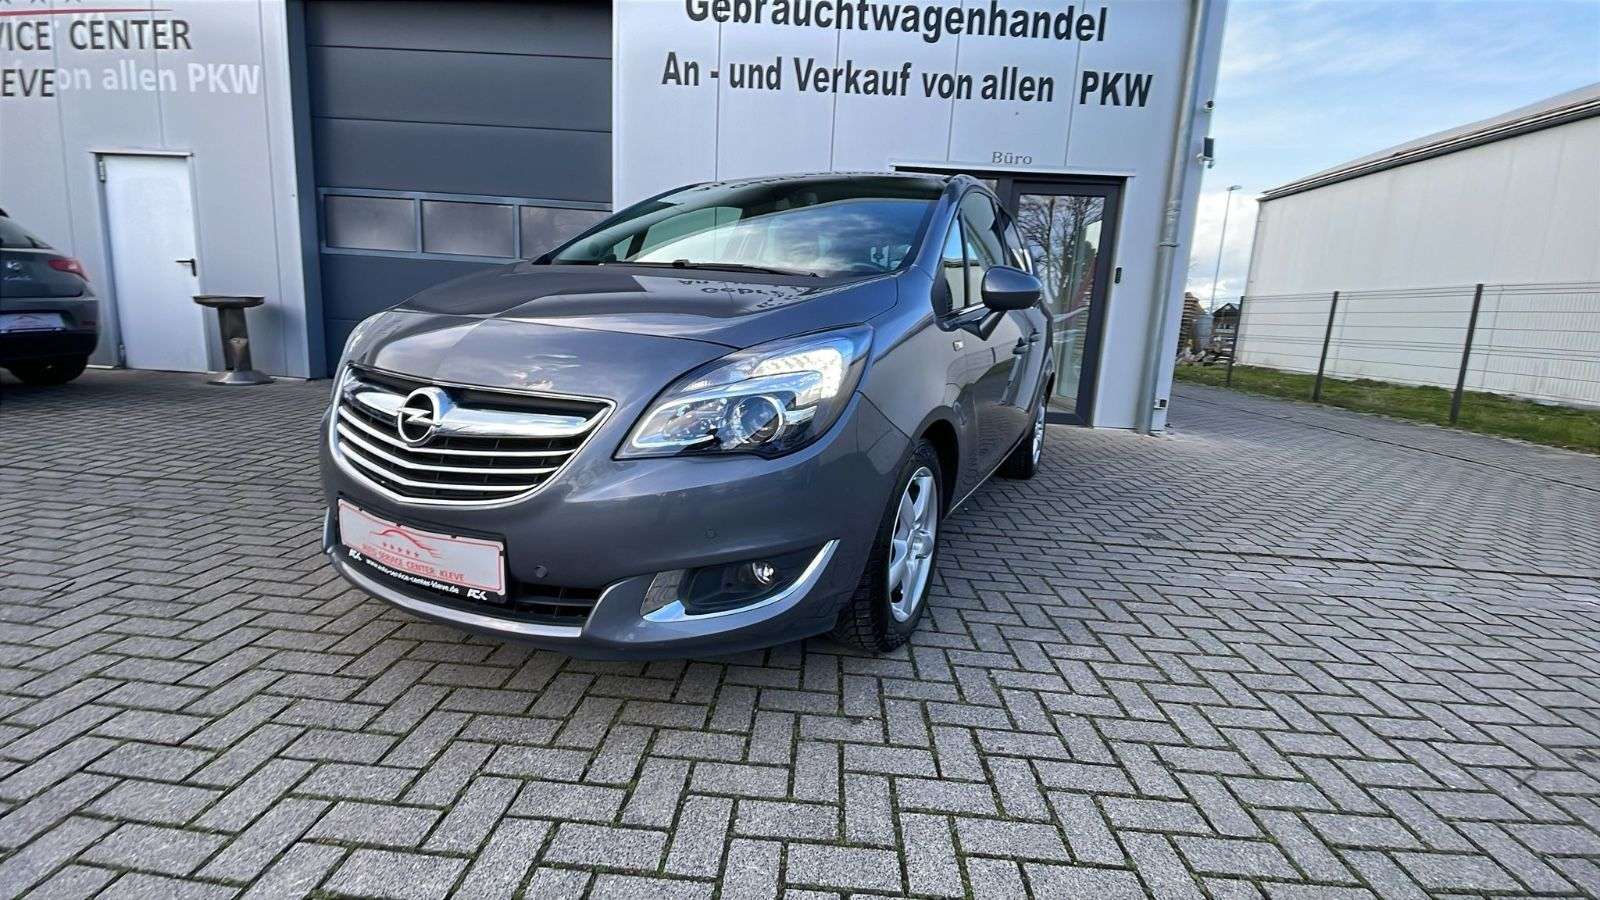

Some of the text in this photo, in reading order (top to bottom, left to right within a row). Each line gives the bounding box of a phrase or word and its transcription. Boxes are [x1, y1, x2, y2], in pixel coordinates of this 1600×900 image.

[69, 19, 193, 50] CENTER
[686, 0, 1107, 43] Gebrauchtwagenhandel
[1, 68, 56, 97] EVE
[56, 60, 261, 95] on allen PKW
[661, 50, 700, 87] An
[729, 56, 782, 90] und
[793, 57, 913, 97] Verkauf
[922, 71, 973, 100] von
[981, 66, 1054, 102] allen
[1079, 70, 1153, 108] PKW
[991, 151, 1033, 165] Büro
[406, 561, 434, 575] CENTER
[439, 570, 464, 582] KLEVE
